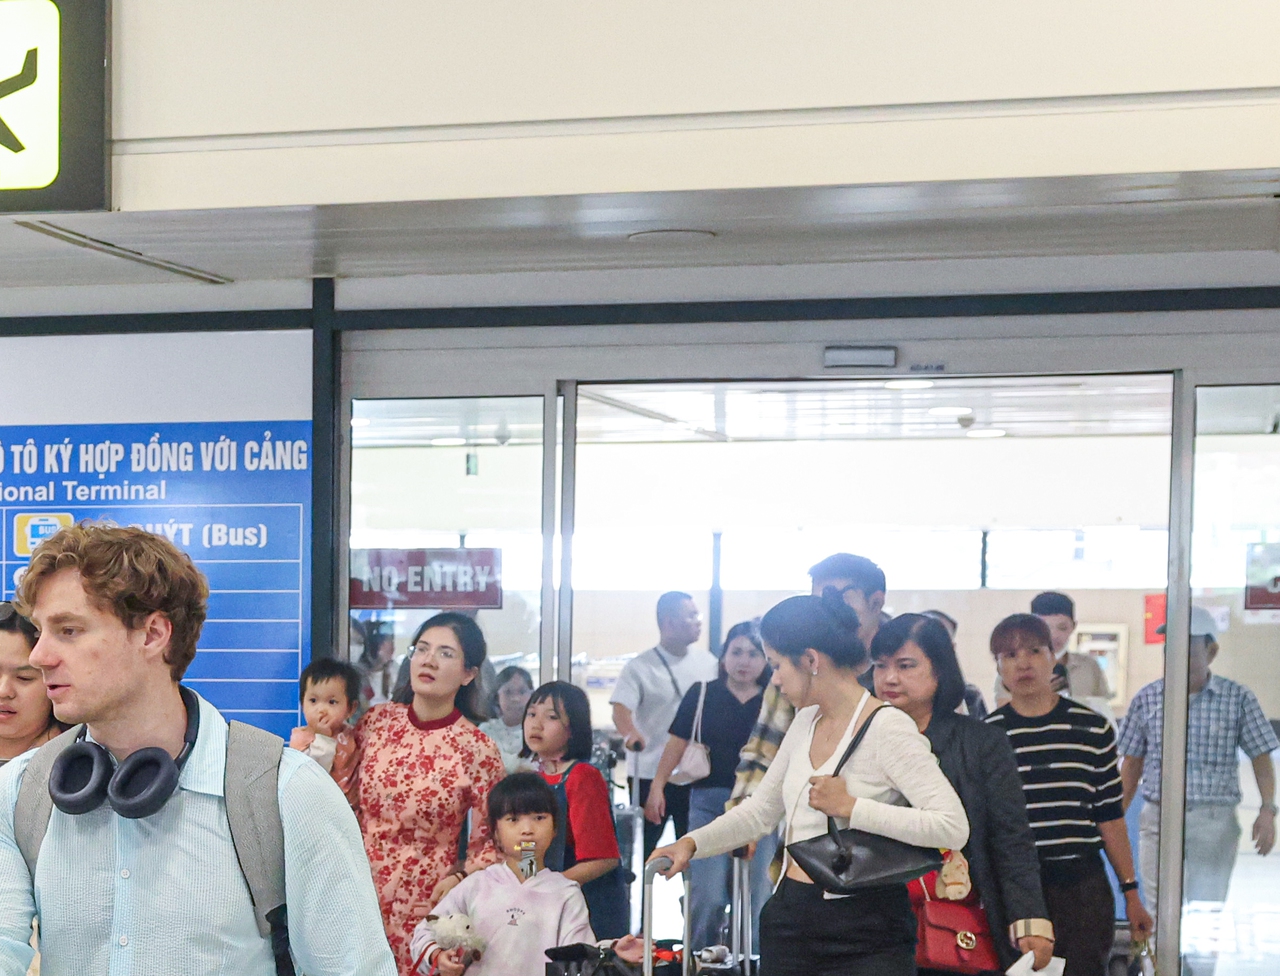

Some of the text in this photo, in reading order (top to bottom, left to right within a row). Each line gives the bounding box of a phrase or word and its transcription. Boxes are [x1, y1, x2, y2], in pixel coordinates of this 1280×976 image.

[10, 438, 38, 474] TÔ
[44, 438, 73, 474] KÝ
[78, 440, 125, 480] HỢP
[130, 432, 194, 473] ĐỒNG
[200, 434, 237, 472] VỚI
[244, 430, 308, 471] CẢNG
[62, 479, 166, 501] Terminal
[202, 523, 268, 548] (Bus)
[362, 566, 491, 592] NO ENTRY
